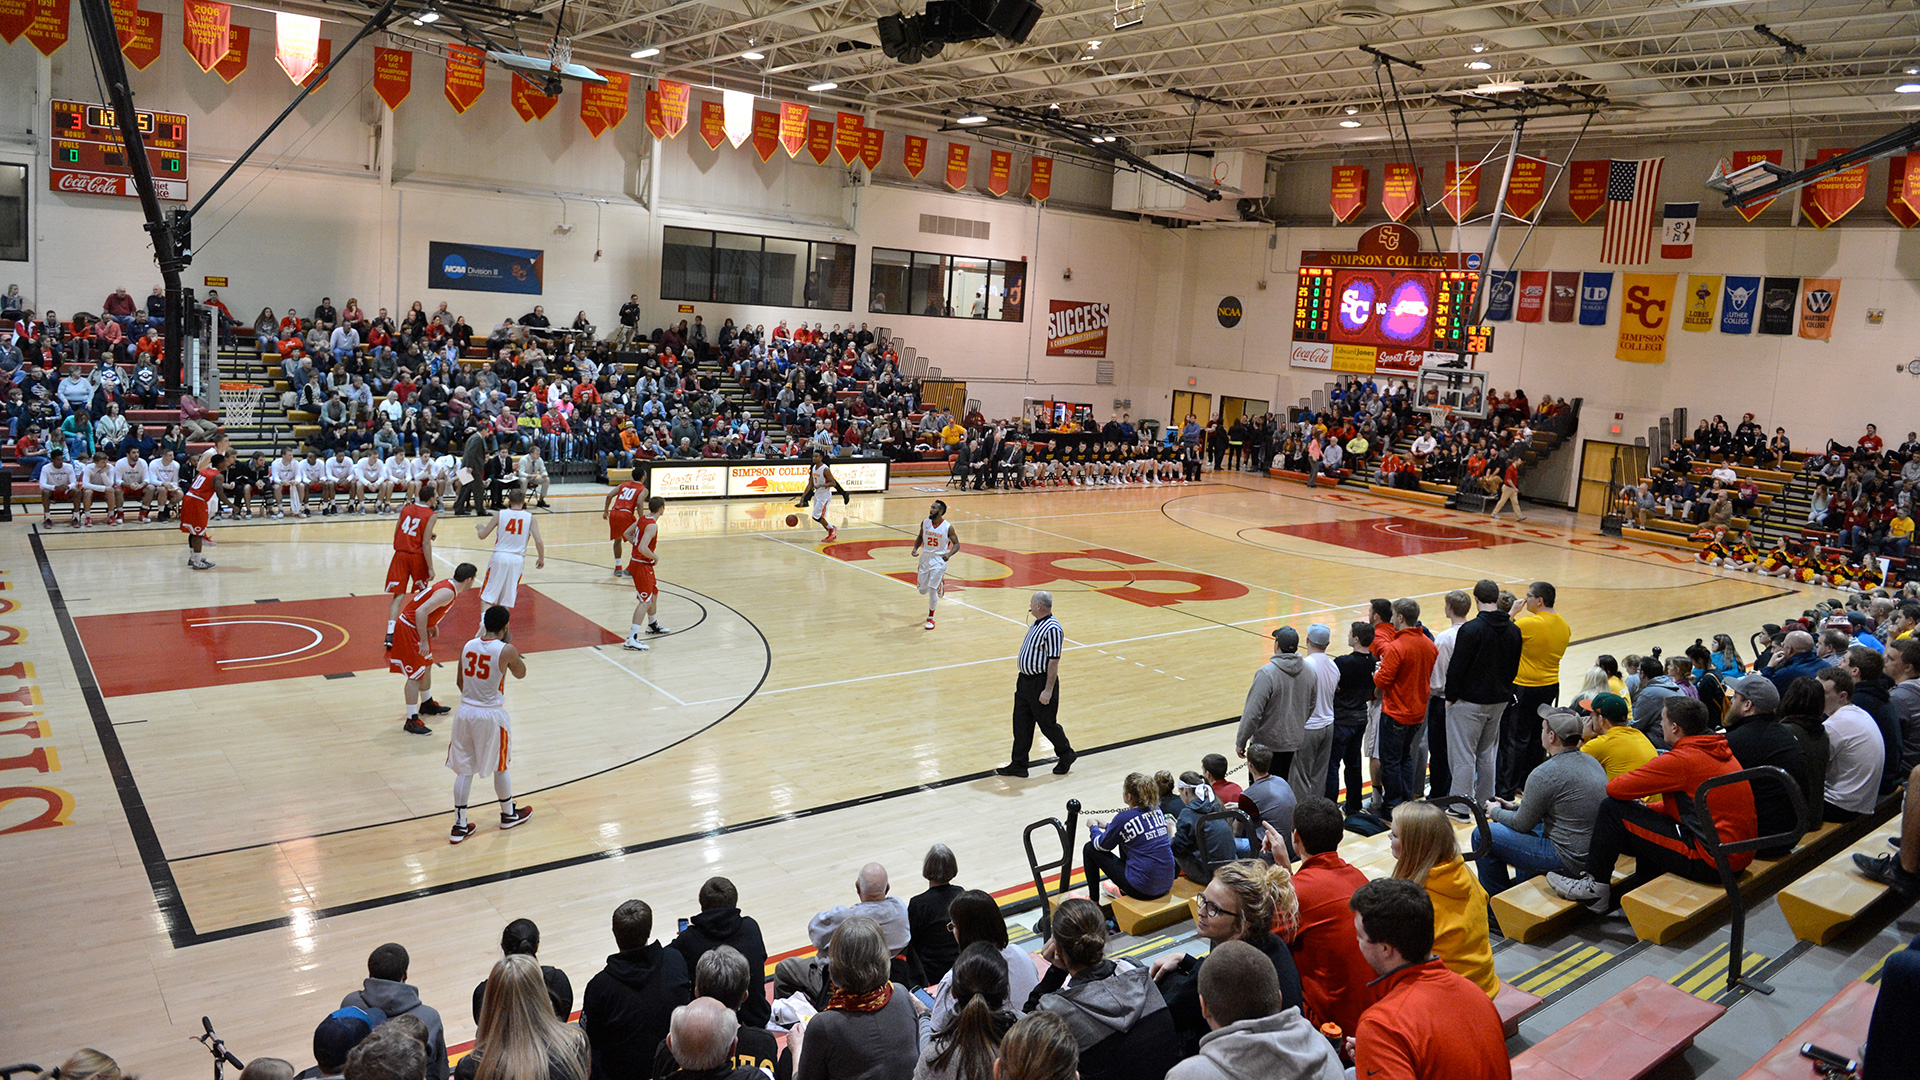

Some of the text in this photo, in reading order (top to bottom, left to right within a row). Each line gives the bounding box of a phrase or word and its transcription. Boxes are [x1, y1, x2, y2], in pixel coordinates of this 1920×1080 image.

[193, 4, 220, 17] 2006
[35, 16, 61, 25] HAMPIONS
[187, 20, 225, 32] CHAMPIONS
[191, 28, 221, 39] WOMEN'S
[384, 53, 404, 63] 1991
[377, 67, 409, 76] CHAMPIONS
[666, 85, 683, 95] 2010
[54, 102, 84, 113] HOME
[788, 106, 803, 116] 2012
[71, 113, 82, 130] 3
[155, 113, 186, 125] VISITOR
[64, 130, 86, 139] BONUS
[172, 124, 183, 141] 0
[59, 140, 80, 149] FOULS
[154, 139, 176, 148] BONUS
[98, 144, 123, 154] PLAYER
[69, 149, 79, 162] 0
[160, 150, 180, 159] FOULS
[1746, 154, 1767, 163] 1999
[170, 159, 180, 172] 0
[1516, 162, 1537, 170] 1998
[1339, 169, 1355, 177] 1997
[1379, 225, 1400, 251] SC
[1329, 254, 1448, 267] SIMPSON COLLEGE
[444, 264, 466, 274] NCAA
[467, 266, 493, 276] Division
[1302, 276, 1310, 285] 11
[1314, 276, 1321, 286] 0
[1298, 287, 1308, 297] 25
[1313, 287, 1320, 297] 0
[1297, 298, 1307, 307] 31
[1438, 292, 1450, 303] 30
[1806, 291, 1836, 312] W
[1312, 298, 1319, 308] 0
[1341, 288, 1370, 324] SC
[1626, 285, 1666, 329] SC
[1218, 306, 1241, 317] NCAA
[1296, 308, 1306, 318] 35
[1375, 302, 1388, 315] VS
[1311, 309, 1318, 319] 0
[1727, 311, 1749, 319] LUTHER
[1048, 303, 1109, 340] SUCCESS
[1295, 320, 1305, 328] 41
[1310, 320, 1317, 330] 0
[1685, 317, 1713, 325] COLLEGE
[1806, 321, 1826, 329] COLLEGE
[1434, 328, 1446, 339] 42
[1452, 329, 1460, 340] 0
[1468, 325, 1492, 336] 18:05
[1467, 336, 1487, 353] 28
[1335, 347, 1375, 357] Edward Jones
[1377, 351, 1403, 366] Sports
[1403, 350, 1423, 366] Page
[732, 467, 776, 477] SIMPSON
[660, 469, 716, 488] Sports Page
[764, 479, 806, 492] STORM
[618, 486, 637, 501] 30
[401, 515, 421, 537] 42
[505, 518, 523, 536] 41
[927, 537, 939, 547] 25
[464, 651, 492, 680] 35
[1119, 815, 1145, 843] LSU
